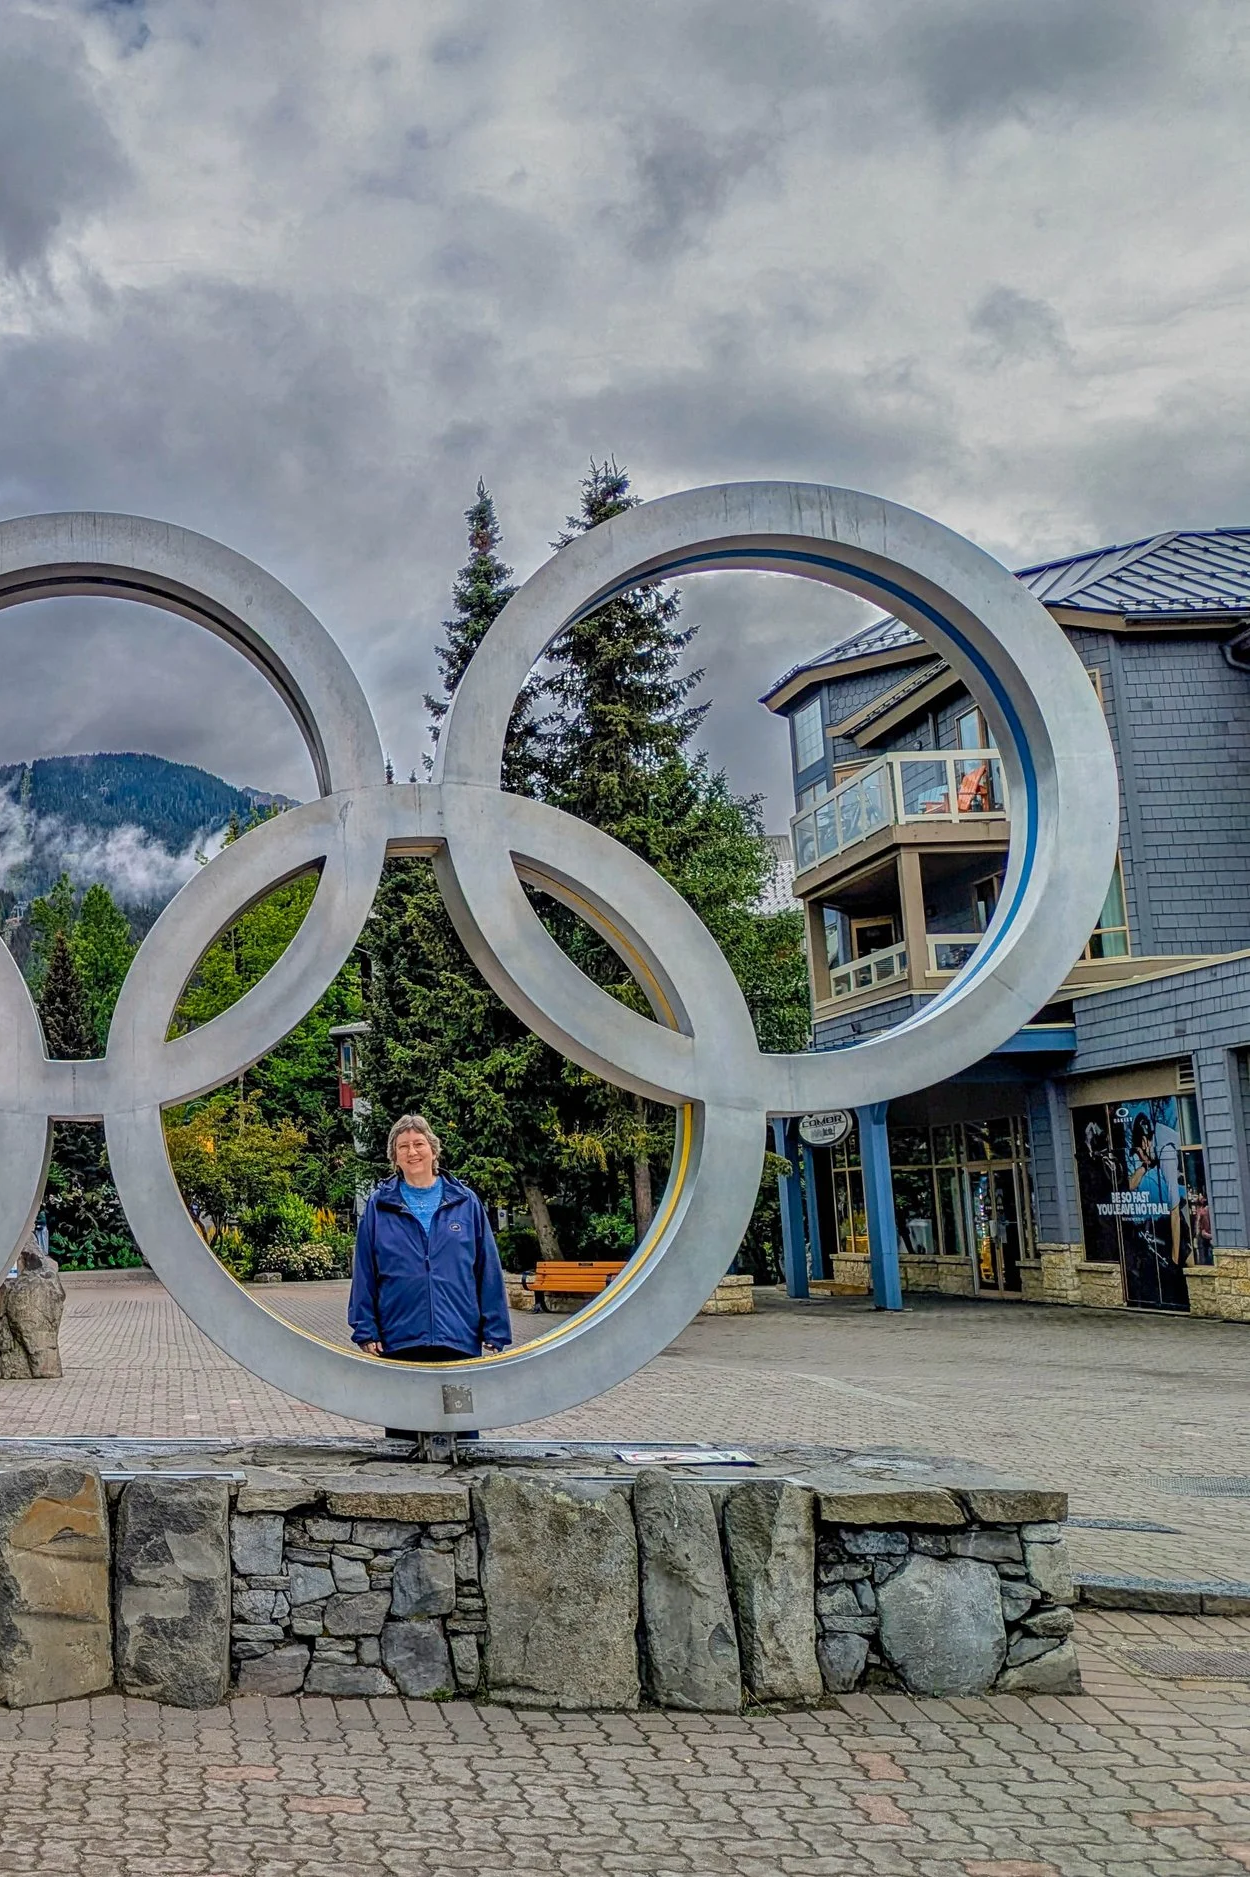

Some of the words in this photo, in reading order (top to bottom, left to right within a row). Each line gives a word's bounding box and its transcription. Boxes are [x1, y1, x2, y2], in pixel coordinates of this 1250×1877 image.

[1111, 1192, 1121, 1203] BE
[1121, 1191, 1131, 1202] SO
[1132, 1191, 1150, 1202] FAST
[1096, 1204, 1113, 1215] YOU
[1113, 1203, 1135, 1215] LEAVE
[1135, 1203, 1147, 1214] NO
[1147, 1203, 1170, 1214] TRAIL
